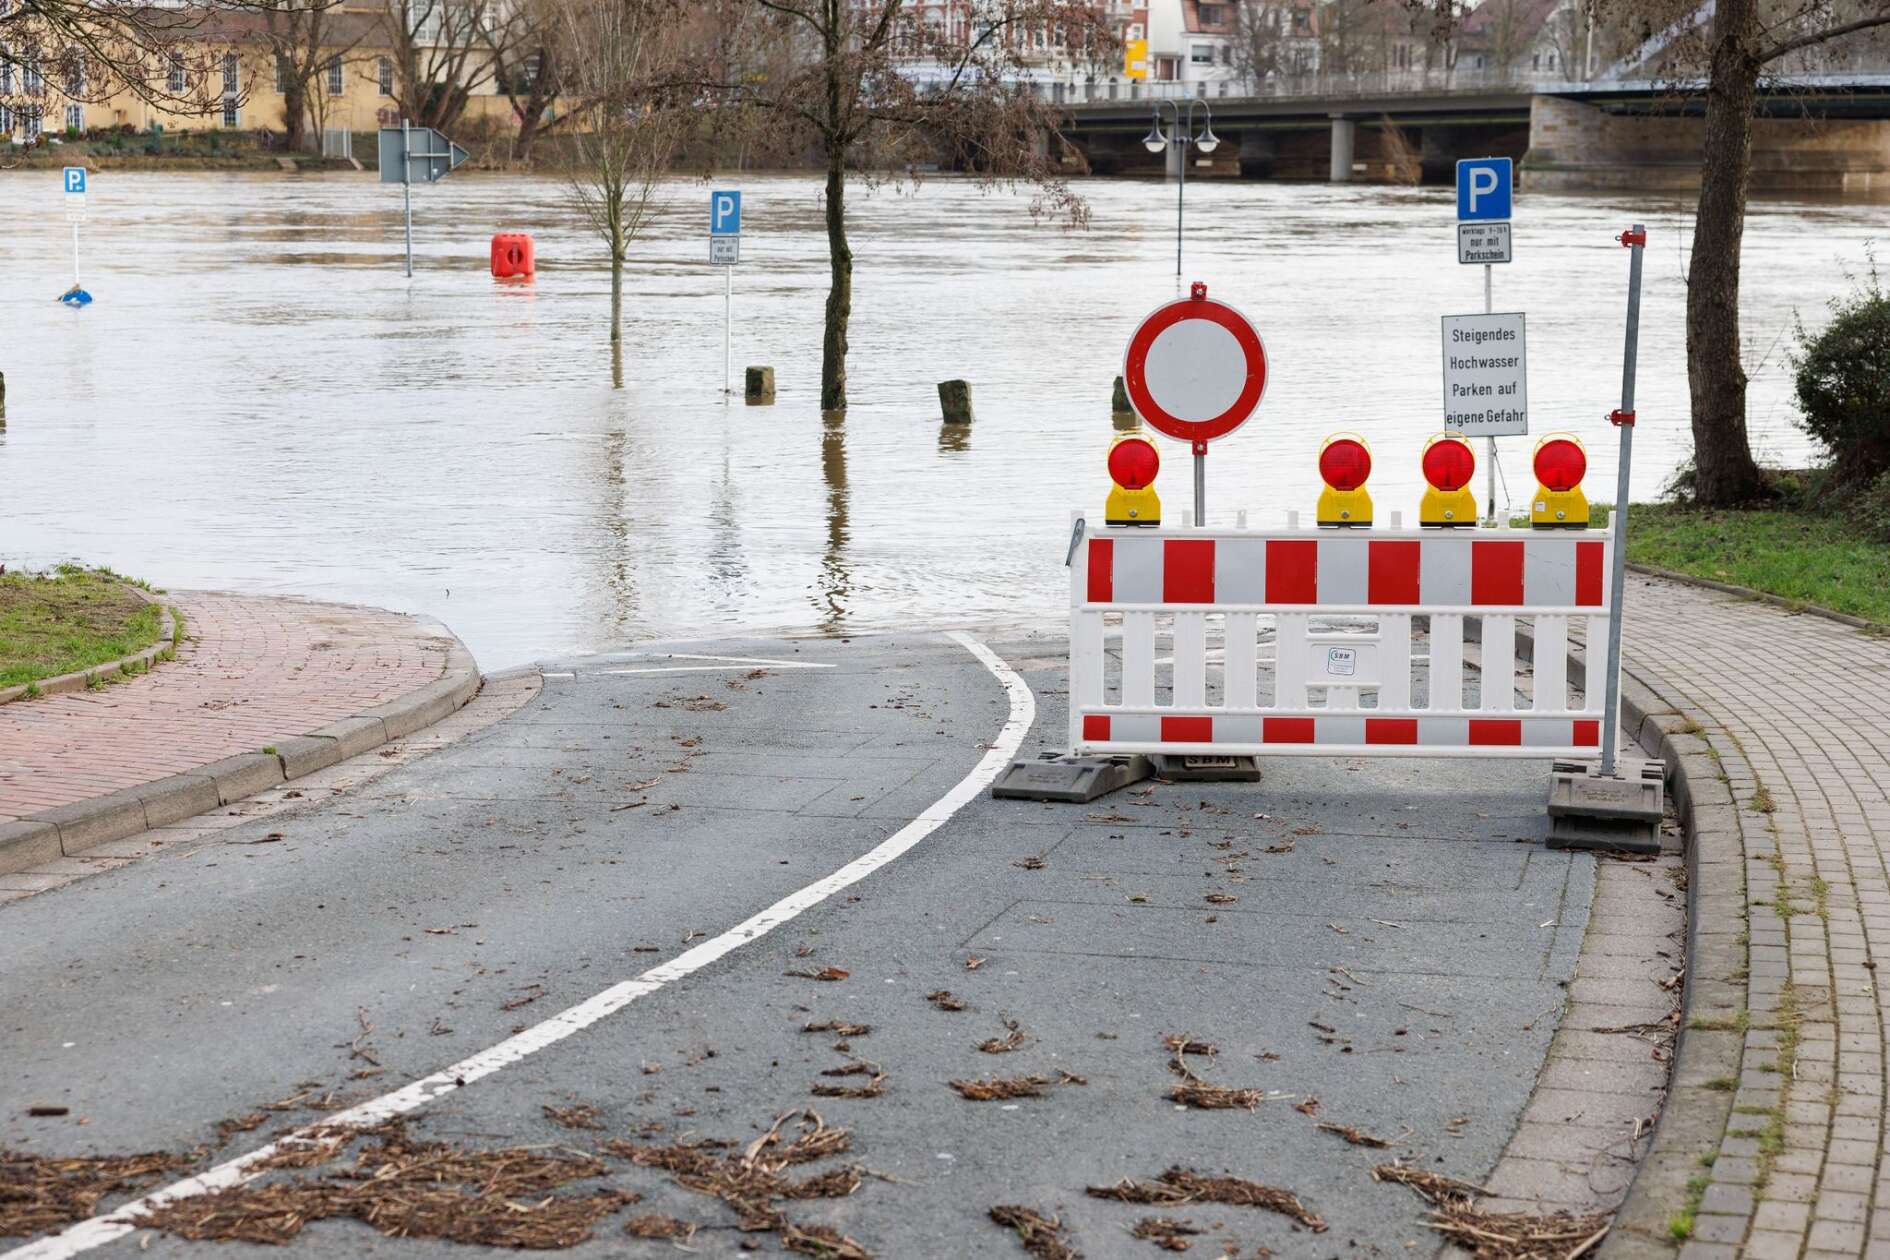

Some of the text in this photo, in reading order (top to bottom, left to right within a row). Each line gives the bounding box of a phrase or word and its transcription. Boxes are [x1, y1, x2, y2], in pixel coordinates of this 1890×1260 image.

[69, 170, 81, 191] P
[1469, 167, 1499, 213] P
[717, 196, 734, 229] P
[1487, 236, 1499, 246] mit
[1465, 249, 1505, 260] Parkschein
[1452, 328, 1516, 345] Steigendes
[1450, 356, 1520, 370] Hochwasser
[1452, 381, 1518, 397] Parken auf
[1446, 408, 1525, 427] eigene Gefahr
